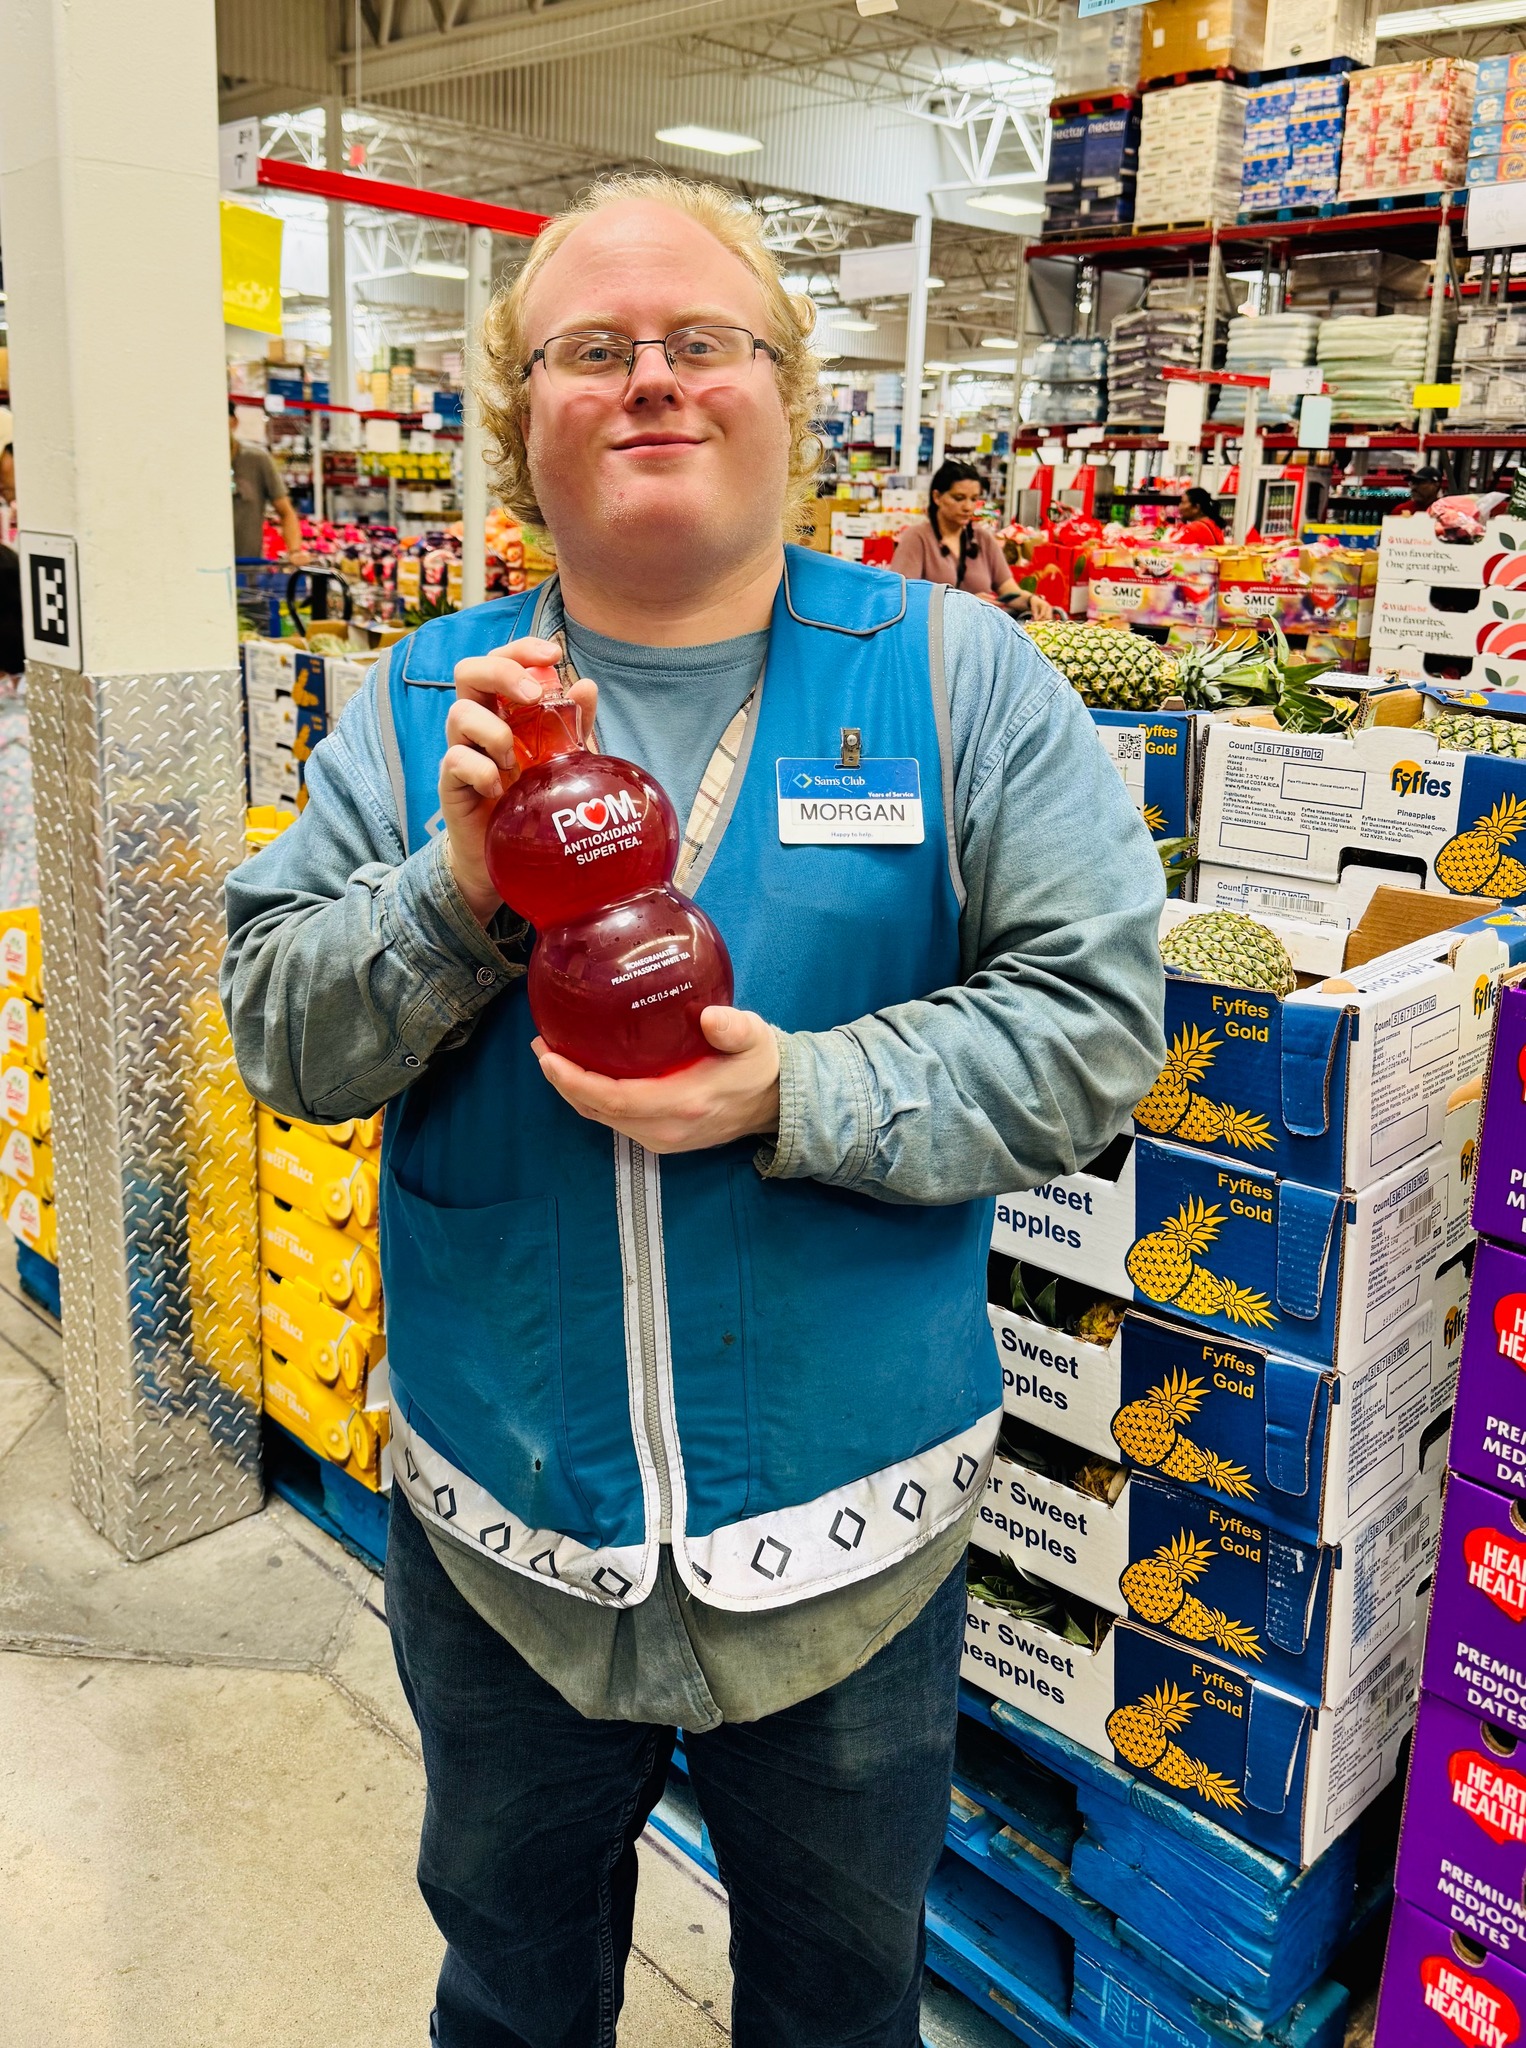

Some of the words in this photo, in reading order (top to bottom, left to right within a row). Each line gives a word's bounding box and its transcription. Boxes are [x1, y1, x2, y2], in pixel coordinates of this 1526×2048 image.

[1088, 119, 1126, 134] nectar
[1385, 561, 1404, 570] One
[1406, 562, 1430, 572] great
[1432, 563, 1460, 574] apple.
[1388, 549, 1405, 558] Two
[1408, 549, 1452, 560] favorites.
[1378, 626, 1398, 636] One
[1399, 627, 1423, 638] great
[1425, 629, 1453, 640] apple.
[1381, 614, 1401, 623] Two
[1403, 615, 1445, 626] favorites.
[1145, 742, 1177, 756] Gold
[1228, 741, 1253, 751] Count
[1303, 749, 1312, 757] 10
[1314, 750, 1322, 759] 12
[814, 776, 840, 786] Sam's
[842, 776, 866, 786] Club
[1391, 768, 1451, 798] fyffes
[800, 803, 905, 821] MORGAN
[1397, 809, 1436, 821] Pineapples
[564, 820, 642, 856] ANTIOXIDANT
[576, 844, 617, 865] SUPER
[1217, 882, 1241, 893] Count
[611, 972, 633, 986] PEACH
[633, 962, 661, 978] PASSION
[661, 955, 681, 967] WHITE
[679, 951, 691, 960] TEA
[631, 1001, 640, 1009] 48
[647, 995, 658, 1004] OZ
[680, 982, 689, 991] 1.4
[1212, 995, 1269, 1021] Fyffes
[1224, 1019, 1269, 1044] Gold
[1374, 1018, 1391, 1033] Count
[1217, 1173, 1273, 1201] Fyffes
[1230, 1198, 1273, 1225] Gold
[996, 1204, 1082, 1249] apples
[1001, 1327, 1079, 1379] Sweet
[1202, 1346, 1256, 1376] Fyffes
[1212, 1372, 1255, 1400] Gold
[1496, 1463, 1526, 1488] DA
[1010, 1481, 1088, 1536] Sweet
[1208, 1509, 1263, 1542] Fyffes
[1219, 1535, 1262, 1564] Gold
[966, 1612, 990, 1634] er
[998, 1623, 1075, 1679] Sweet
[1191, 1663, 1245, 1699] Fyffes
[1202, 1689, 1244, 1720] Gold
[1467, 1688, 1526, 1730] DATES
[1467, 1761, 1526, 1815] HEART
[1440, 1858, 1526, 1922] PREMIUM
[1437, 1877, 1526, 1942] MEDJOOL
[1450, 1904, 1511, 1950] DATES
[1438, 1967, 1501, 2023] HEART
[1424, 1983, 1508, 2048] HEALTHY
